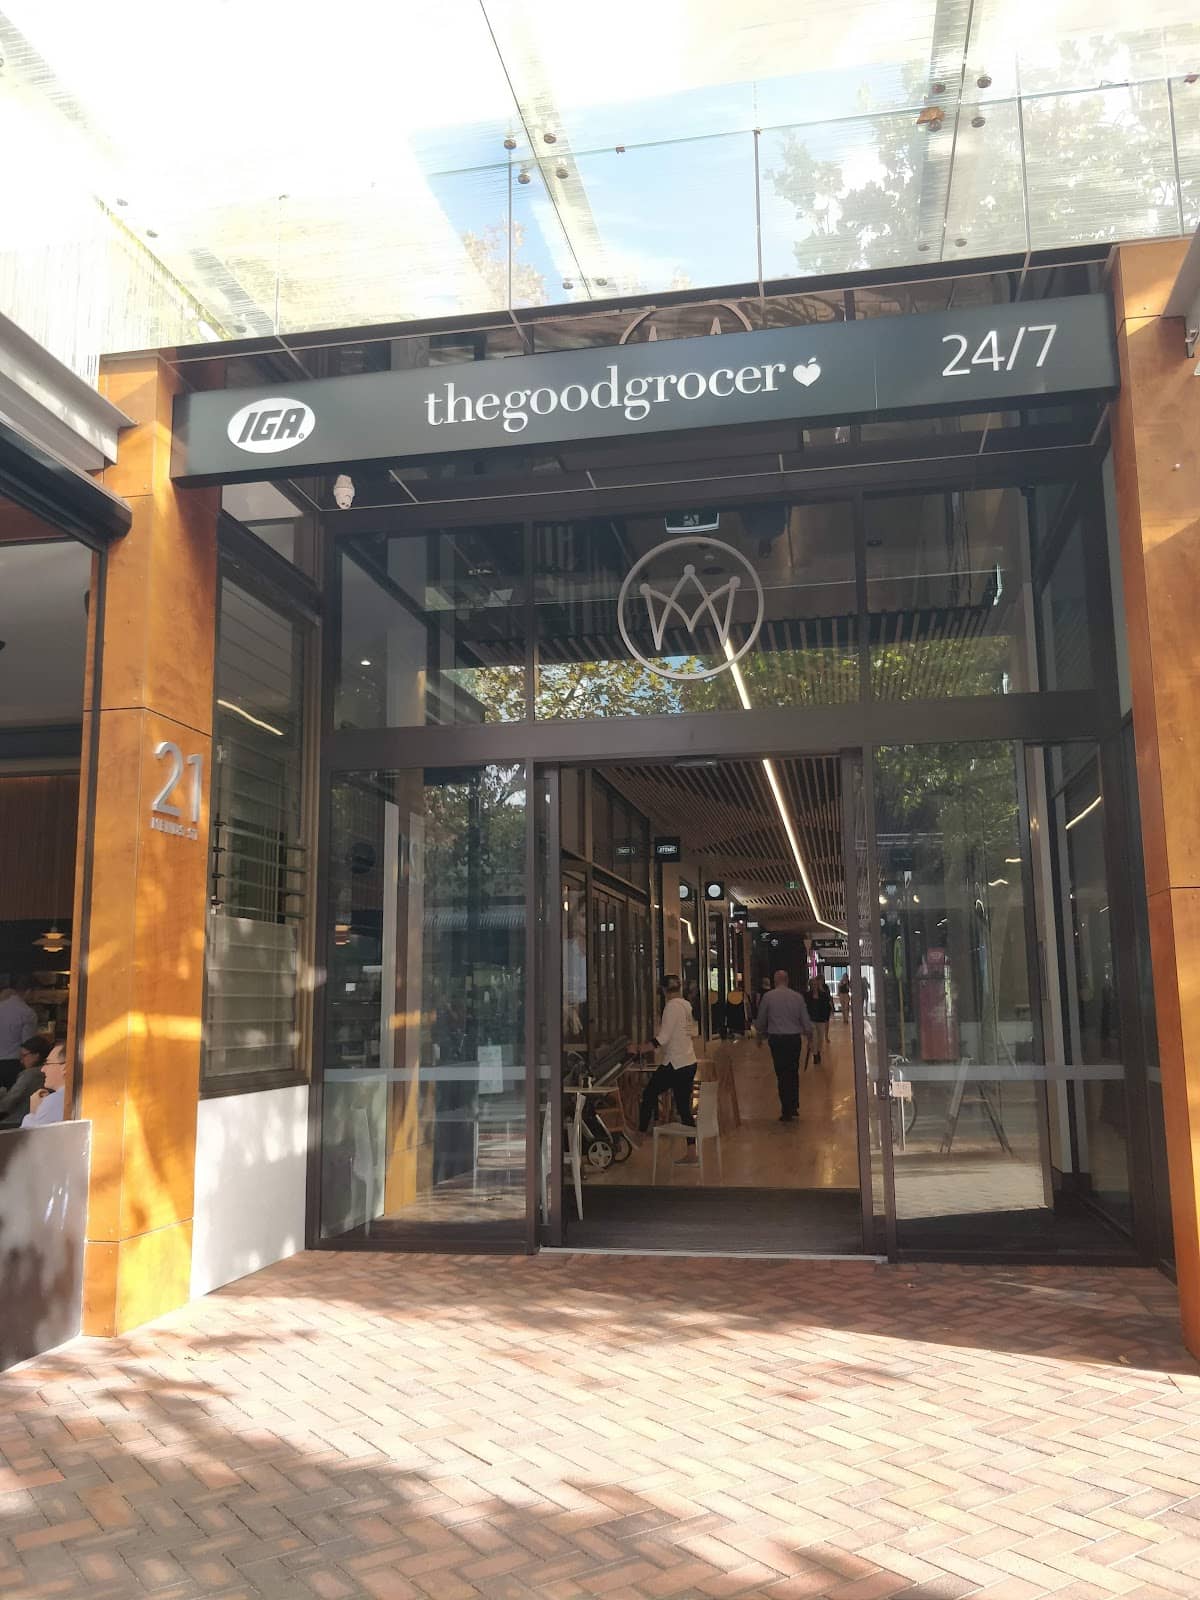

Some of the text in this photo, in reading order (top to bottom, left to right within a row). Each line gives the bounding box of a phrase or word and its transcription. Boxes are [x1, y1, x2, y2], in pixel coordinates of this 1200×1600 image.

[942, 324, 1057, 377] 24/7
[236, 406, 306, 443] IGA
[424, 364, 787, 433] thegoodgrocer
[152, 741, 202, 822] 21
